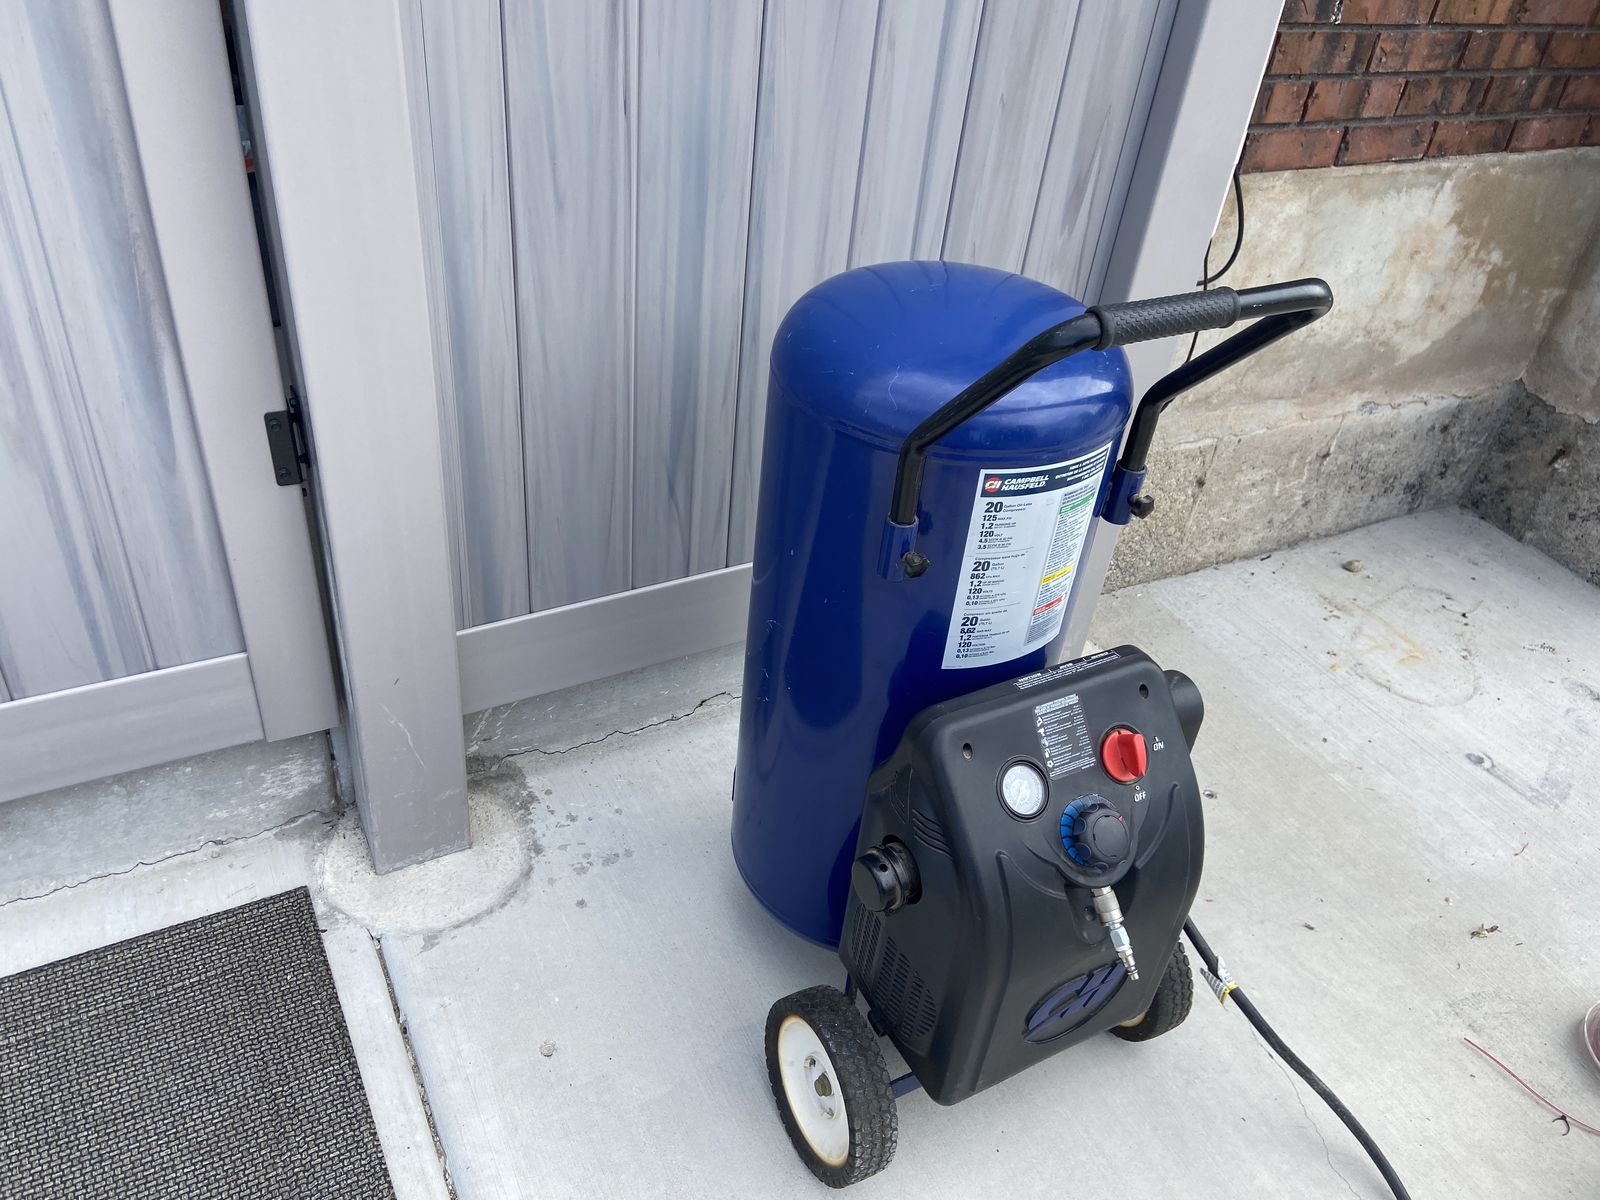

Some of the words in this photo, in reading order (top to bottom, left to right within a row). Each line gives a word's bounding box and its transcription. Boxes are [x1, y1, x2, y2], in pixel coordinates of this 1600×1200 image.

[1004, 474, 1050, 484] CAMPBELL
[1001, 481, 1046, 490] HAUSFELD
[984, 502, 1004, 513] 20
[972, 560, 990, 572] 20
[960, 616, 978, 626] 20
[1154, 741, 1164, 751] ON
[1134, 791, 1146, 802] OFF
